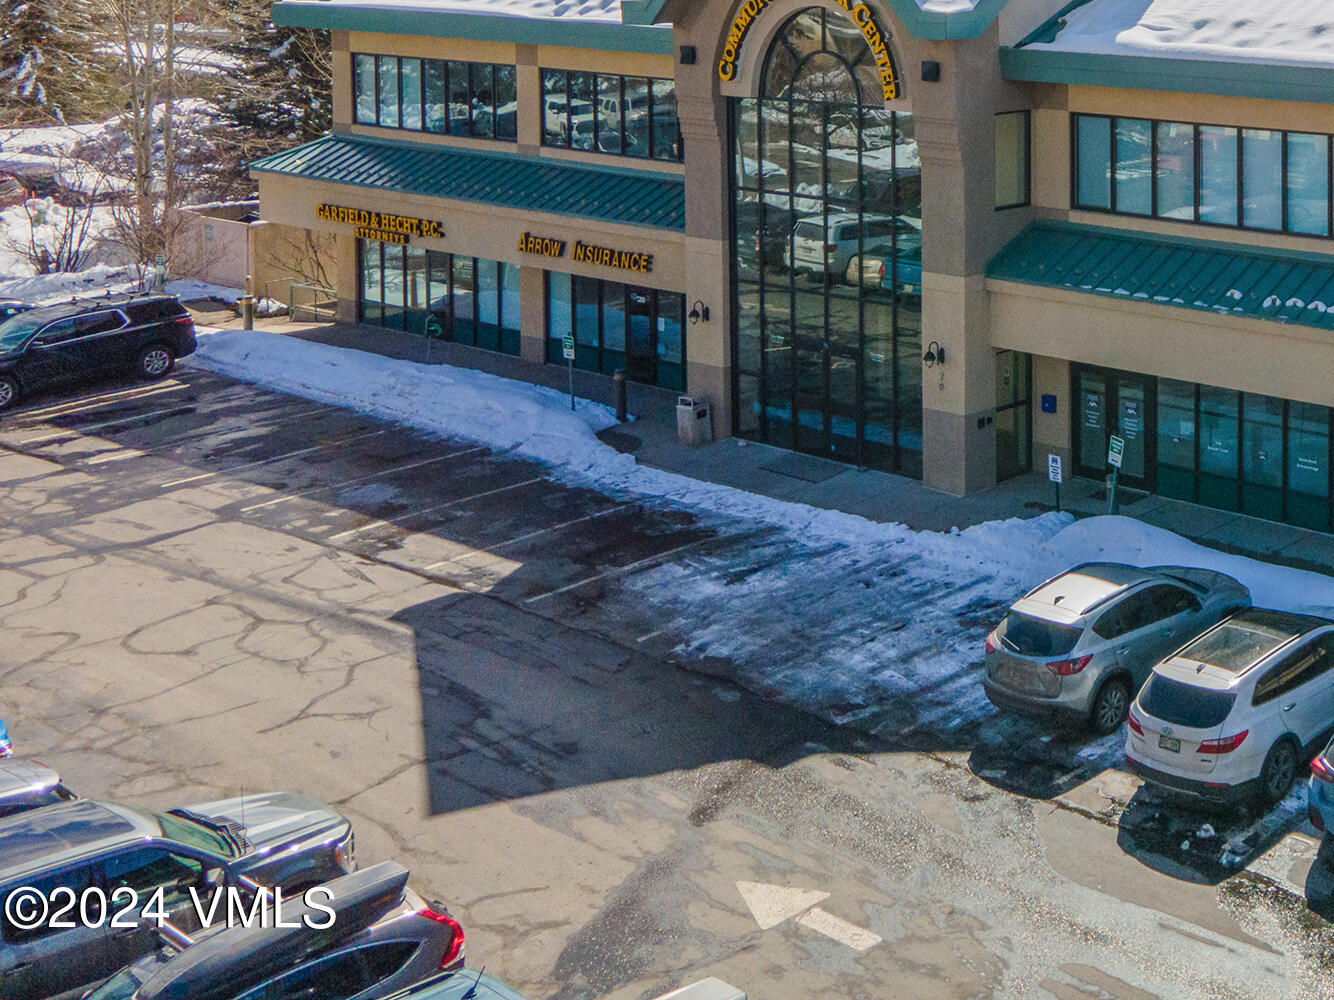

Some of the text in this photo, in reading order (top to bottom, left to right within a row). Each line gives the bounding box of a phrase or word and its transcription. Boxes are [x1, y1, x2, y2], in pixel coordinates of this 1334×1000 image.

[852, 3, 897, 101] CENTER
[315, 203, 442, 239] GARFIELD & HECHT, P.C.
[353, 227, 406, 246] ATTORNEYS
[517, 231, 651, 273] ARROW INSURANCE
